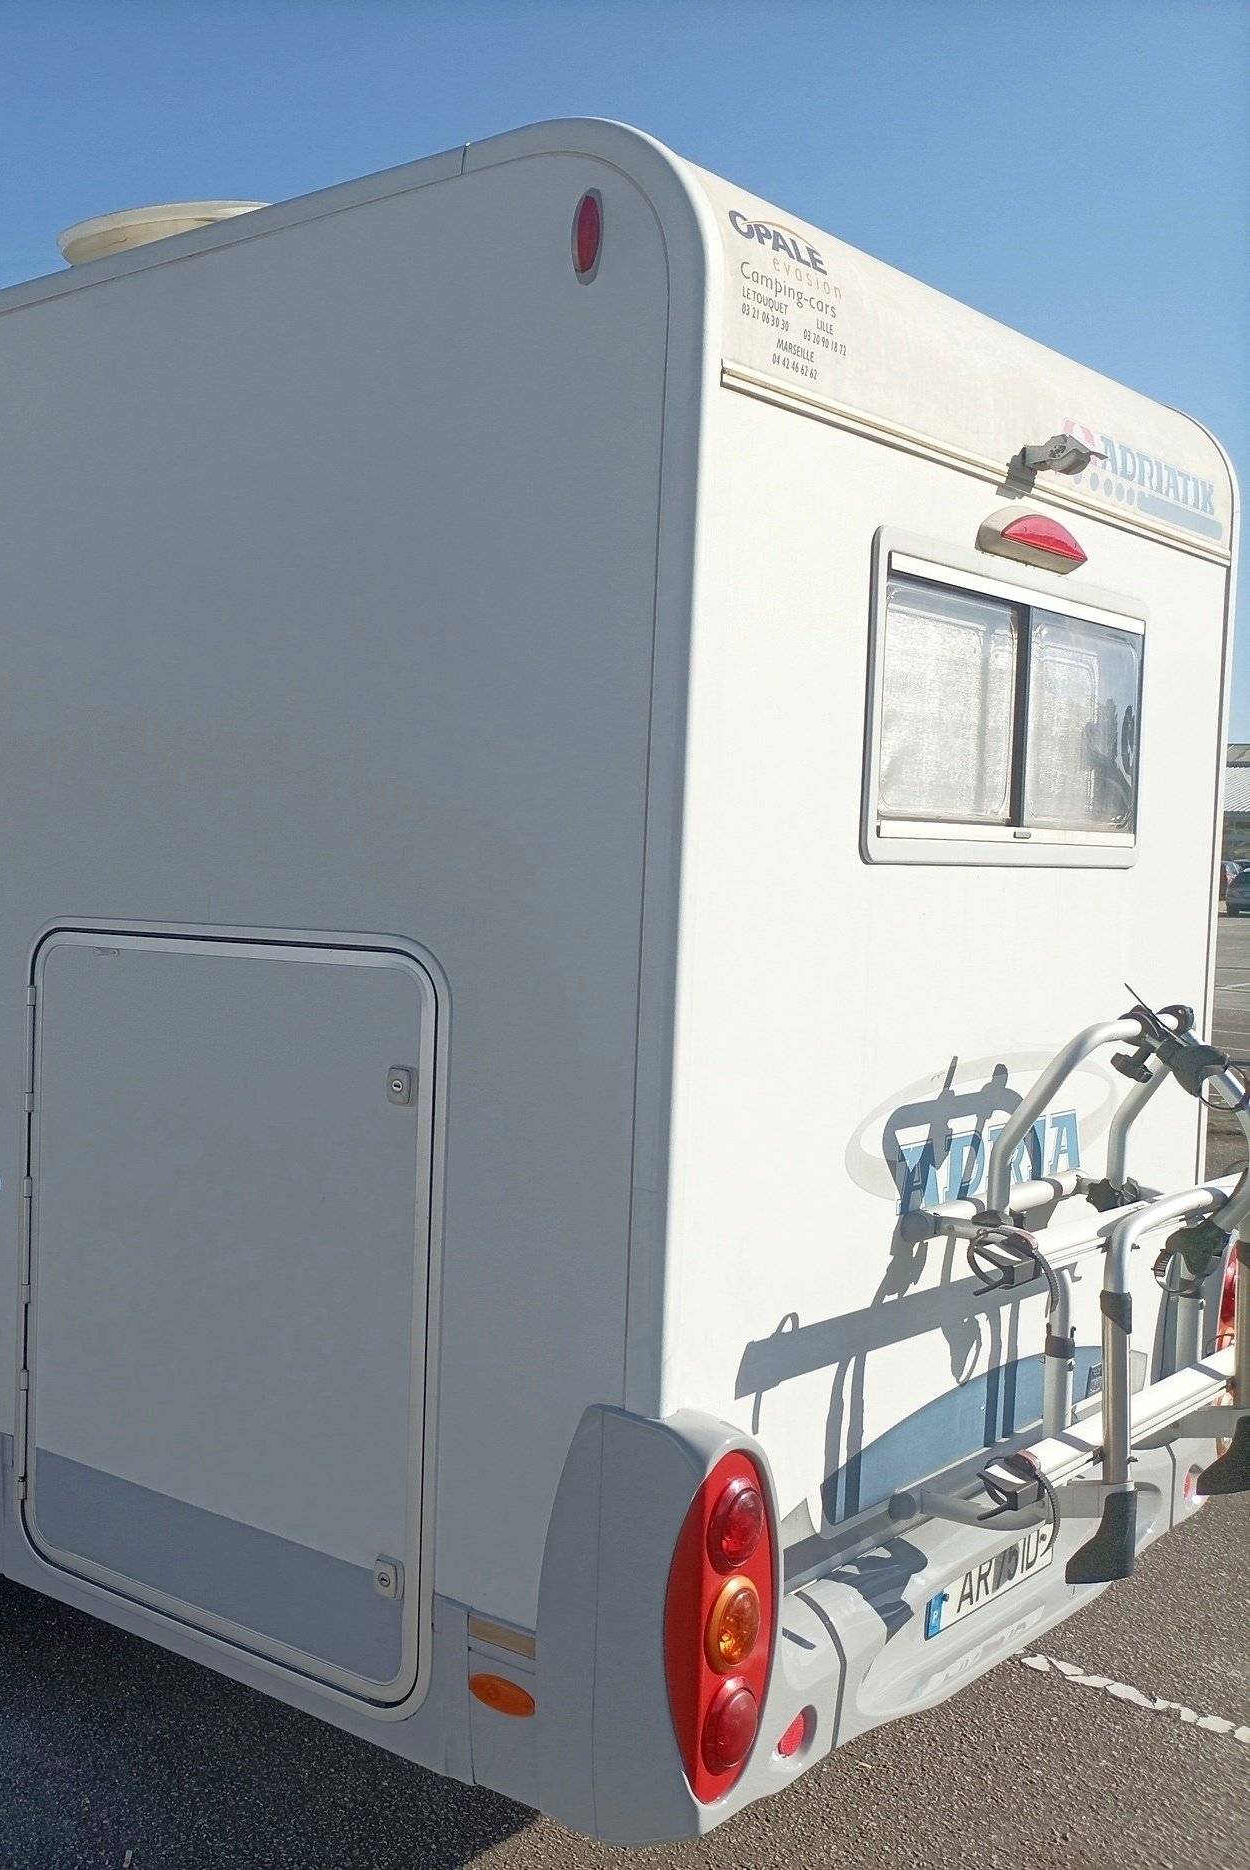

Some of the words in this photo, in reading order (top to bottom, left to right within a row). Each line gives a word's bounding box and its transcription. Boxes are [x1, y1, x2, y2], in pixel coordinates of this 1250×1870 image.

[728, 210, 828, 276] OPALE
[740, 261, 837, 319] Camping-cars
[772, 257, 842, 301] evasion
[741, 302, 751, 317] 03
[816, 317, 834, 336] LILLE
[776, 337, 815, 364] MARSEILLE
[803, 328, 811, 342] 03
[1100, 434, 1216, 517] ADRIATIK
[956, 1557, 994, 1614] AR
